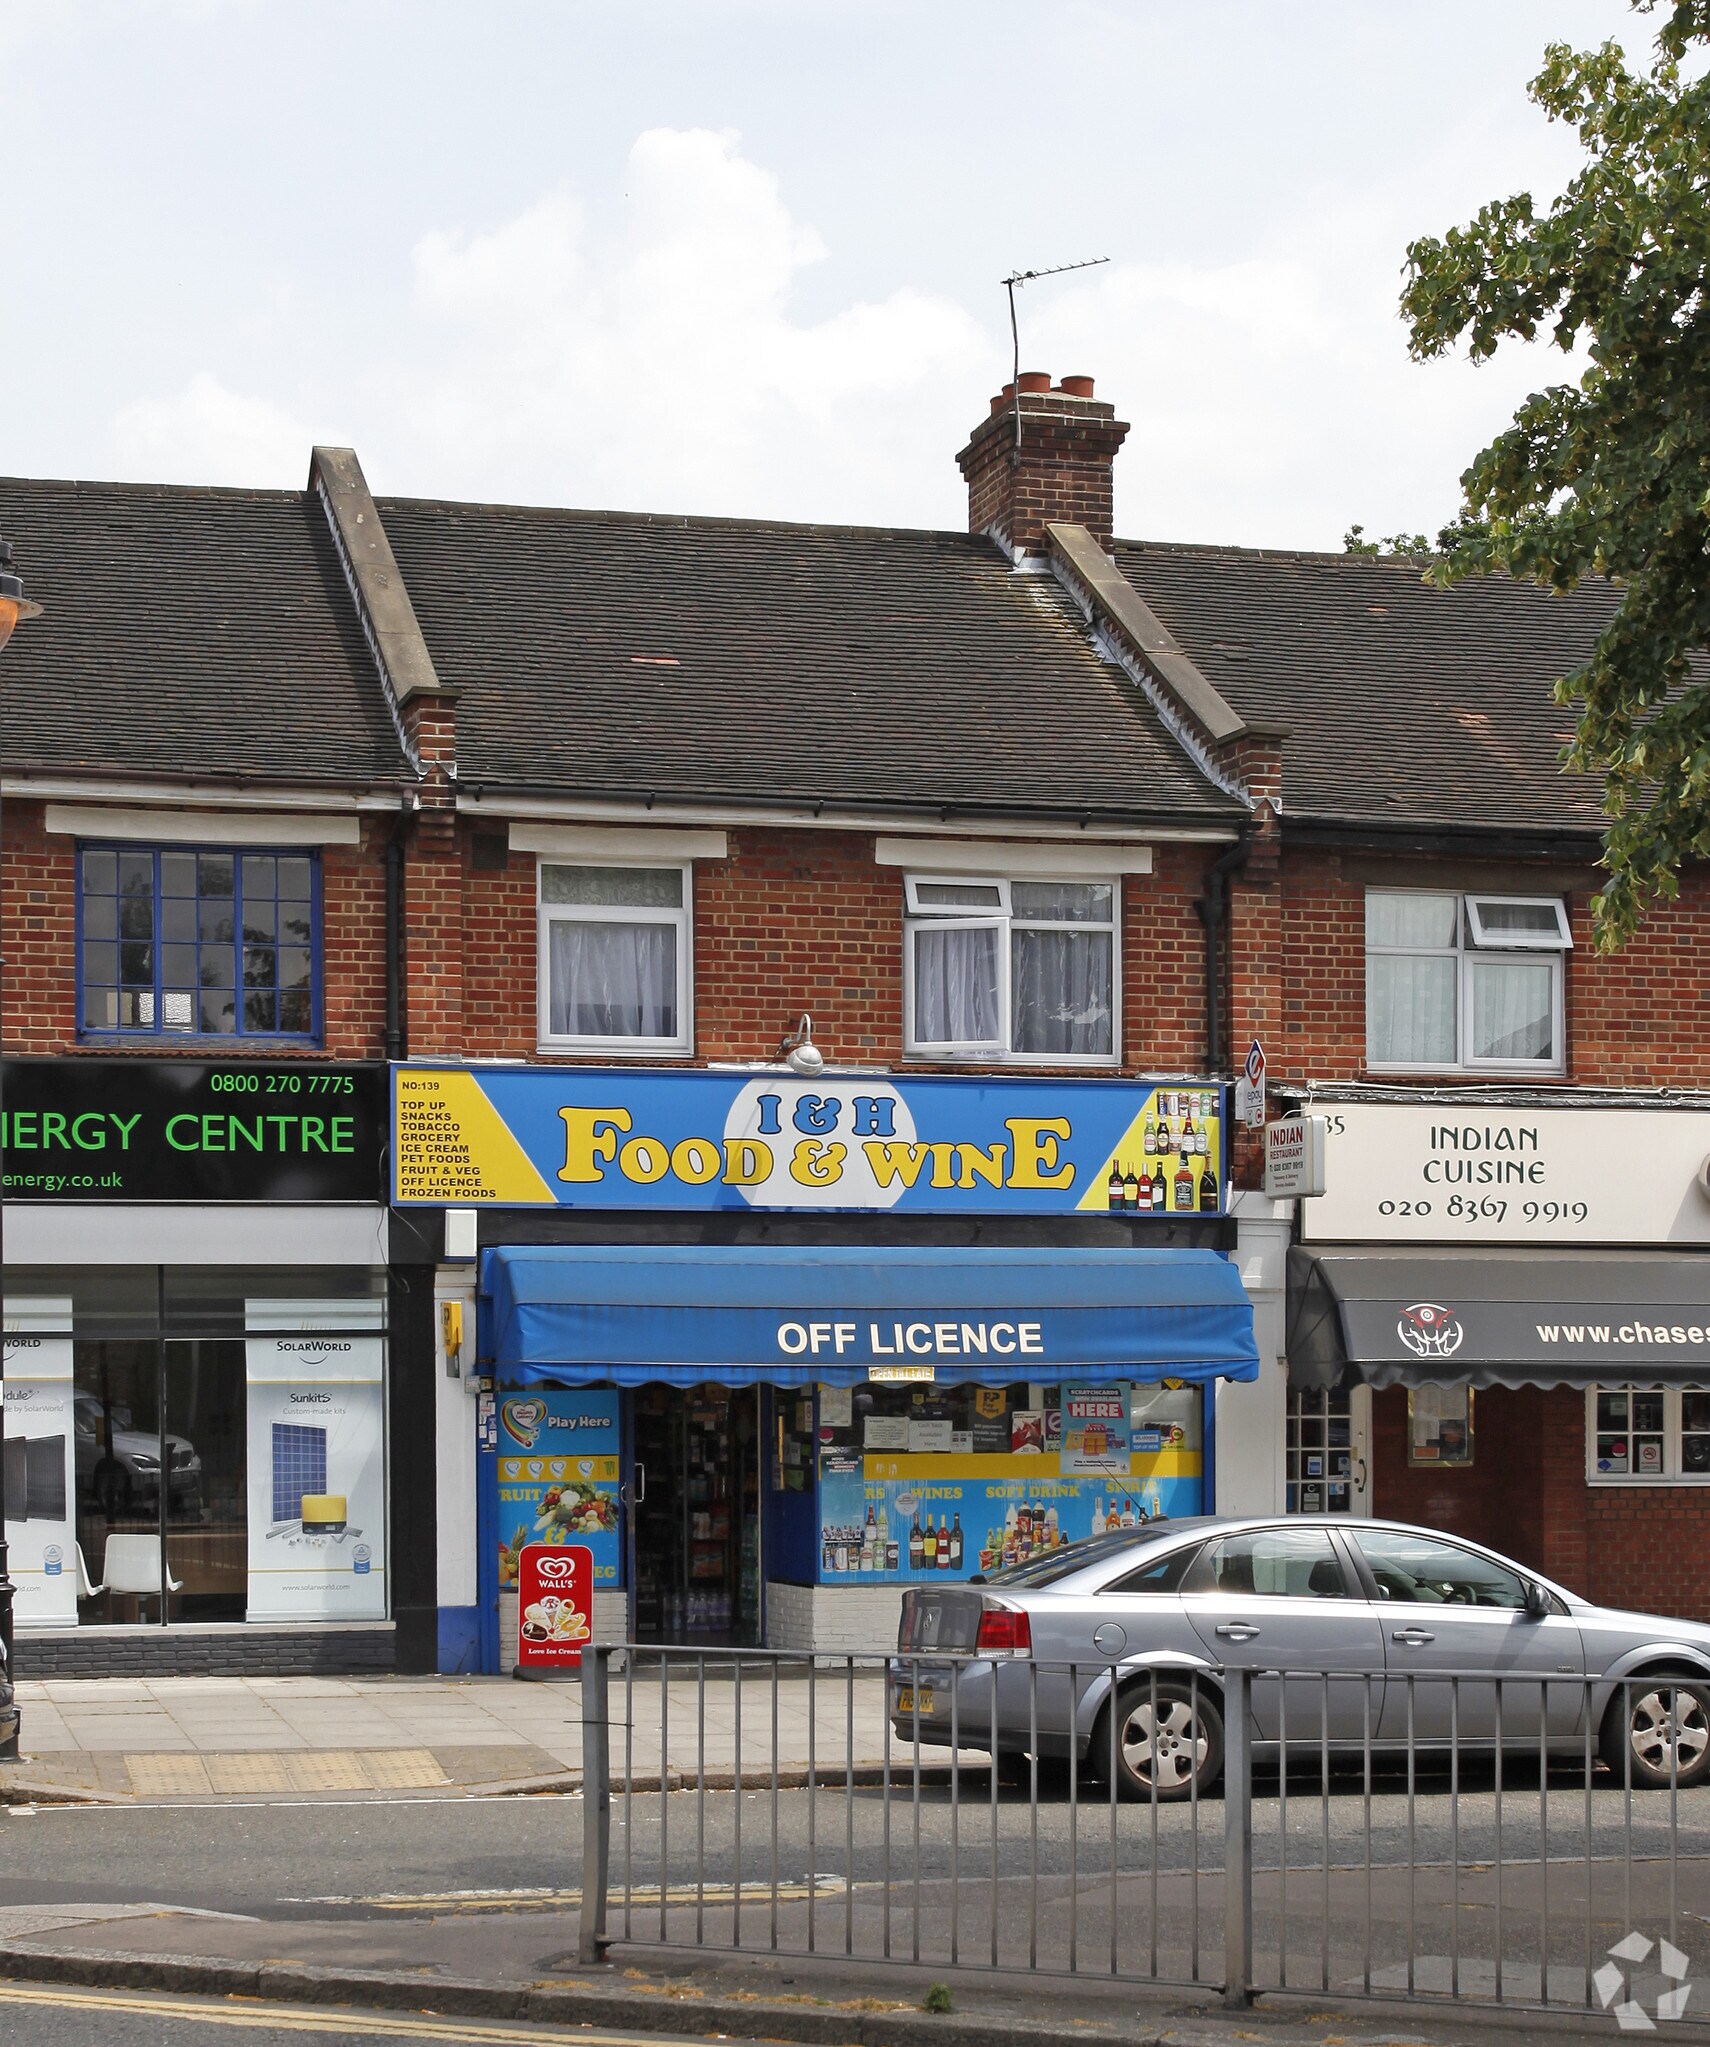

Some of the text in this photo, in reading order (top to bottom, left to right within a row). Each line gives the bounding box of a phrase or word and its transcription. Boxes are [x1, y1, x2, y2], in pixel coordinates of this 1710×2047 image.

[211, 1074, 354, 1094] 0800 270 7775
[401, 1081, 440, 1091] NO:139
[401, 1101, 446, 1110] TOP UP
[401, 1112, 452, 1121] SNACKS
[756, 1093, 897, 1137] I & H
[1, 1112, 355, 1152] ERGY CENTRE
[401, 1122, 460, 1132] TOBACCO
[401, 1133, 461, 1143] GROCERY
[1269, 1126, 1303, 1147] INDIAN
[1430, 1125, 1539, 1151] INDIAN
[401, 1144, 469, 1154] ICE CREAM
[556, 1105, 1077, 1191] FOOD & WINE
[1269, 1147, 1303, 1160] RESTAURANT
[401, 1154, 470, 1164] PET FOODS
[401, 1165, 481, 1176] FRUIT & VEG
[1422, 1158, 1546, 1184] CUISINE
[401, 1177, 482, 1187] OFF LICENCE
[401, 1188, 497, 1199] FROZEN FOODS
[1378, 1194, 1589, 1224] 020 8367 9919
[776, 1322, 1044, 1354] OFF LICENCE
[1072, 1402, 1120, 1417] HERE
[548, 1416, 611, 1430] Play Here
[911, 1487, 963, 1500] WINES
[985, 1485, 1080, 1498] SOFT DRINK
[538, 1579, 574, 1589] WALL'S
